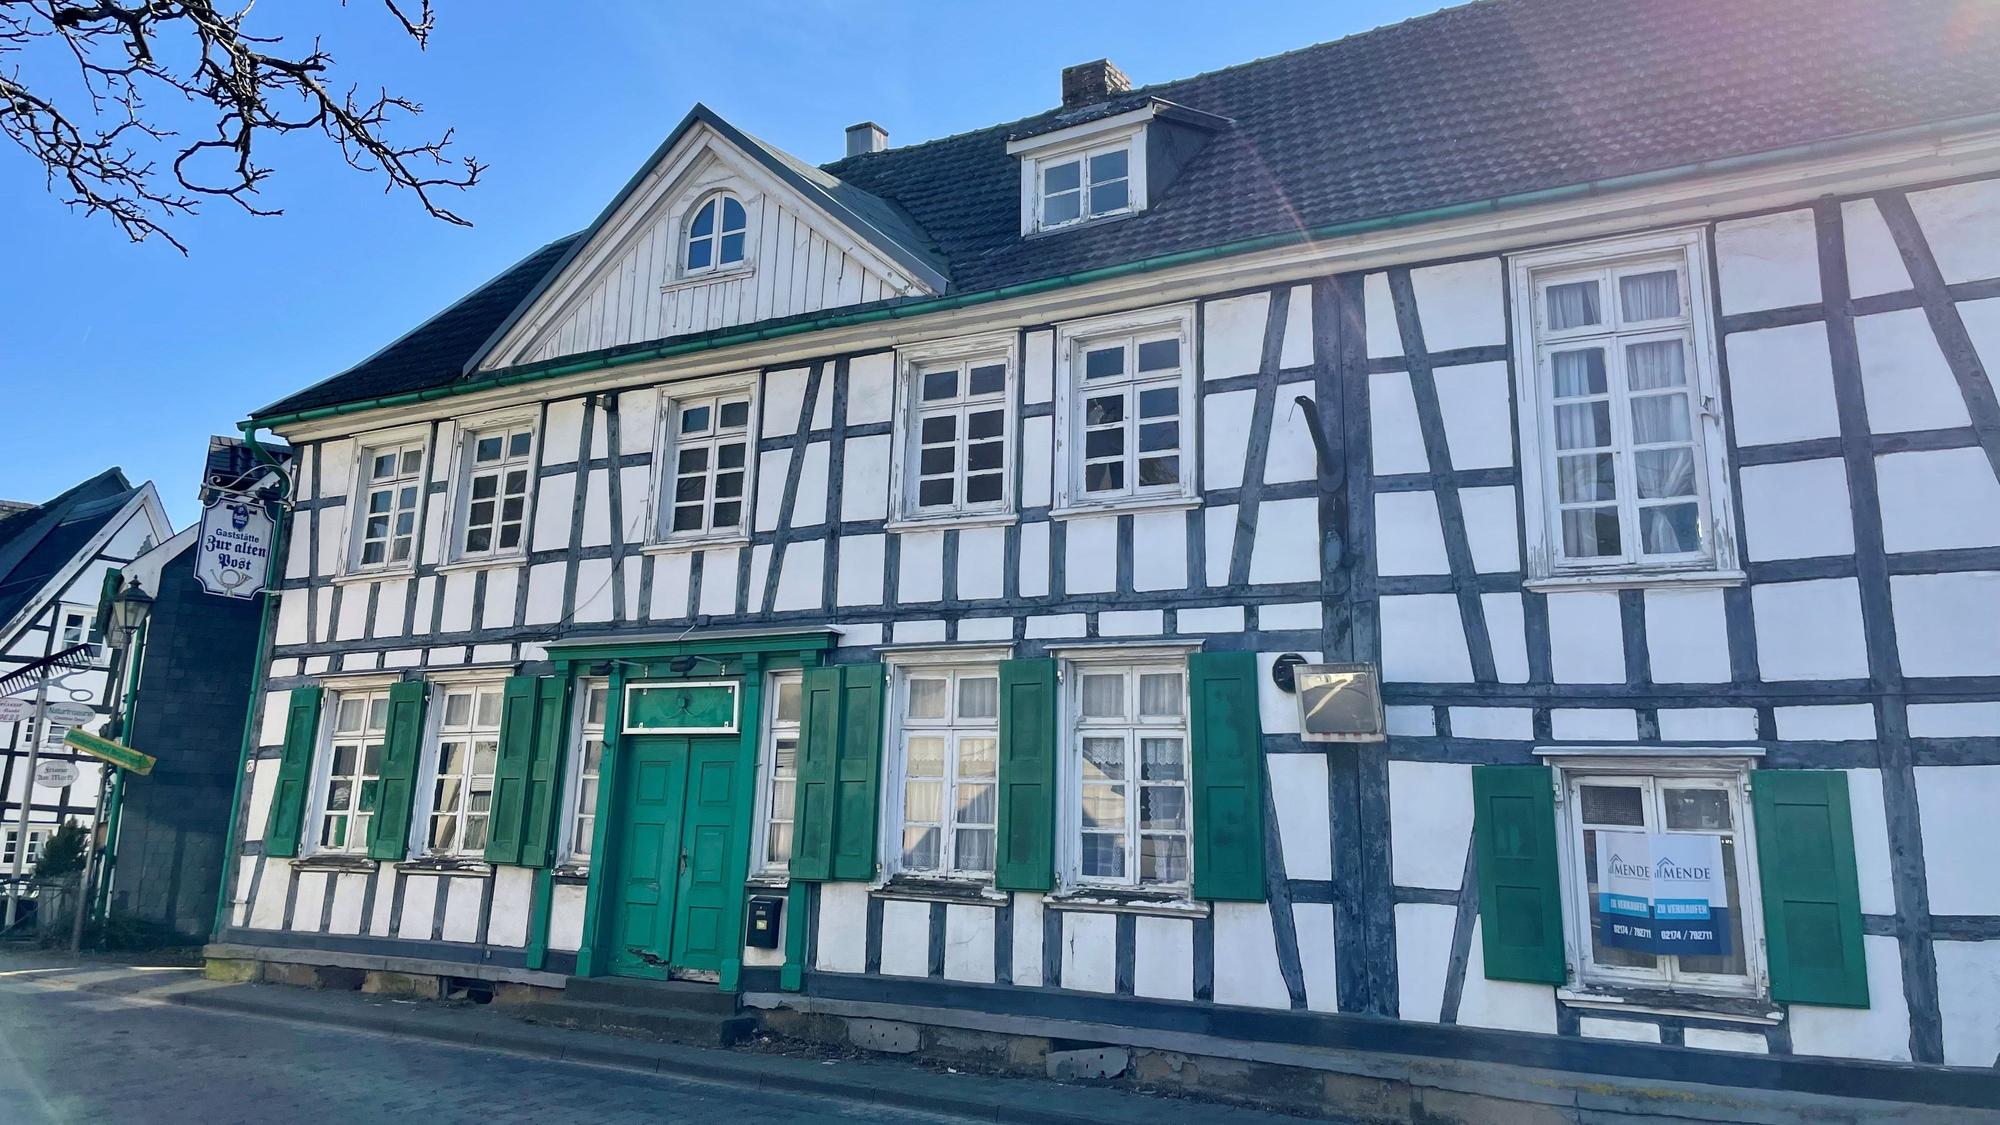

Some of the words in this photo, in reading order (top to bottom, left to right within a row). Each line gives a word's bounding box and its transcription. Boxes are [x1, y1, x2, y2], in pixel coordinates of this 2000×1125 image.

[215, 528, 260, 543] Gaststätte
[205, 535, 232, 552] Zur
[234, 542, 266, 558] alten
[218, 553, 252, 570] Post
[1614, 864, 1650, 878] MENDE
[1663, 867, 1711, 880] MENDE
[1617, 900, 1647, 913] VERKAUFEN
[1656, 903, 1666, 914] ZU
[1667, 904, 1708, 914] VERKAUFEN
[1613, 924, 1628, 935] 02174
[1660, 930, 1682, 940] 02174
